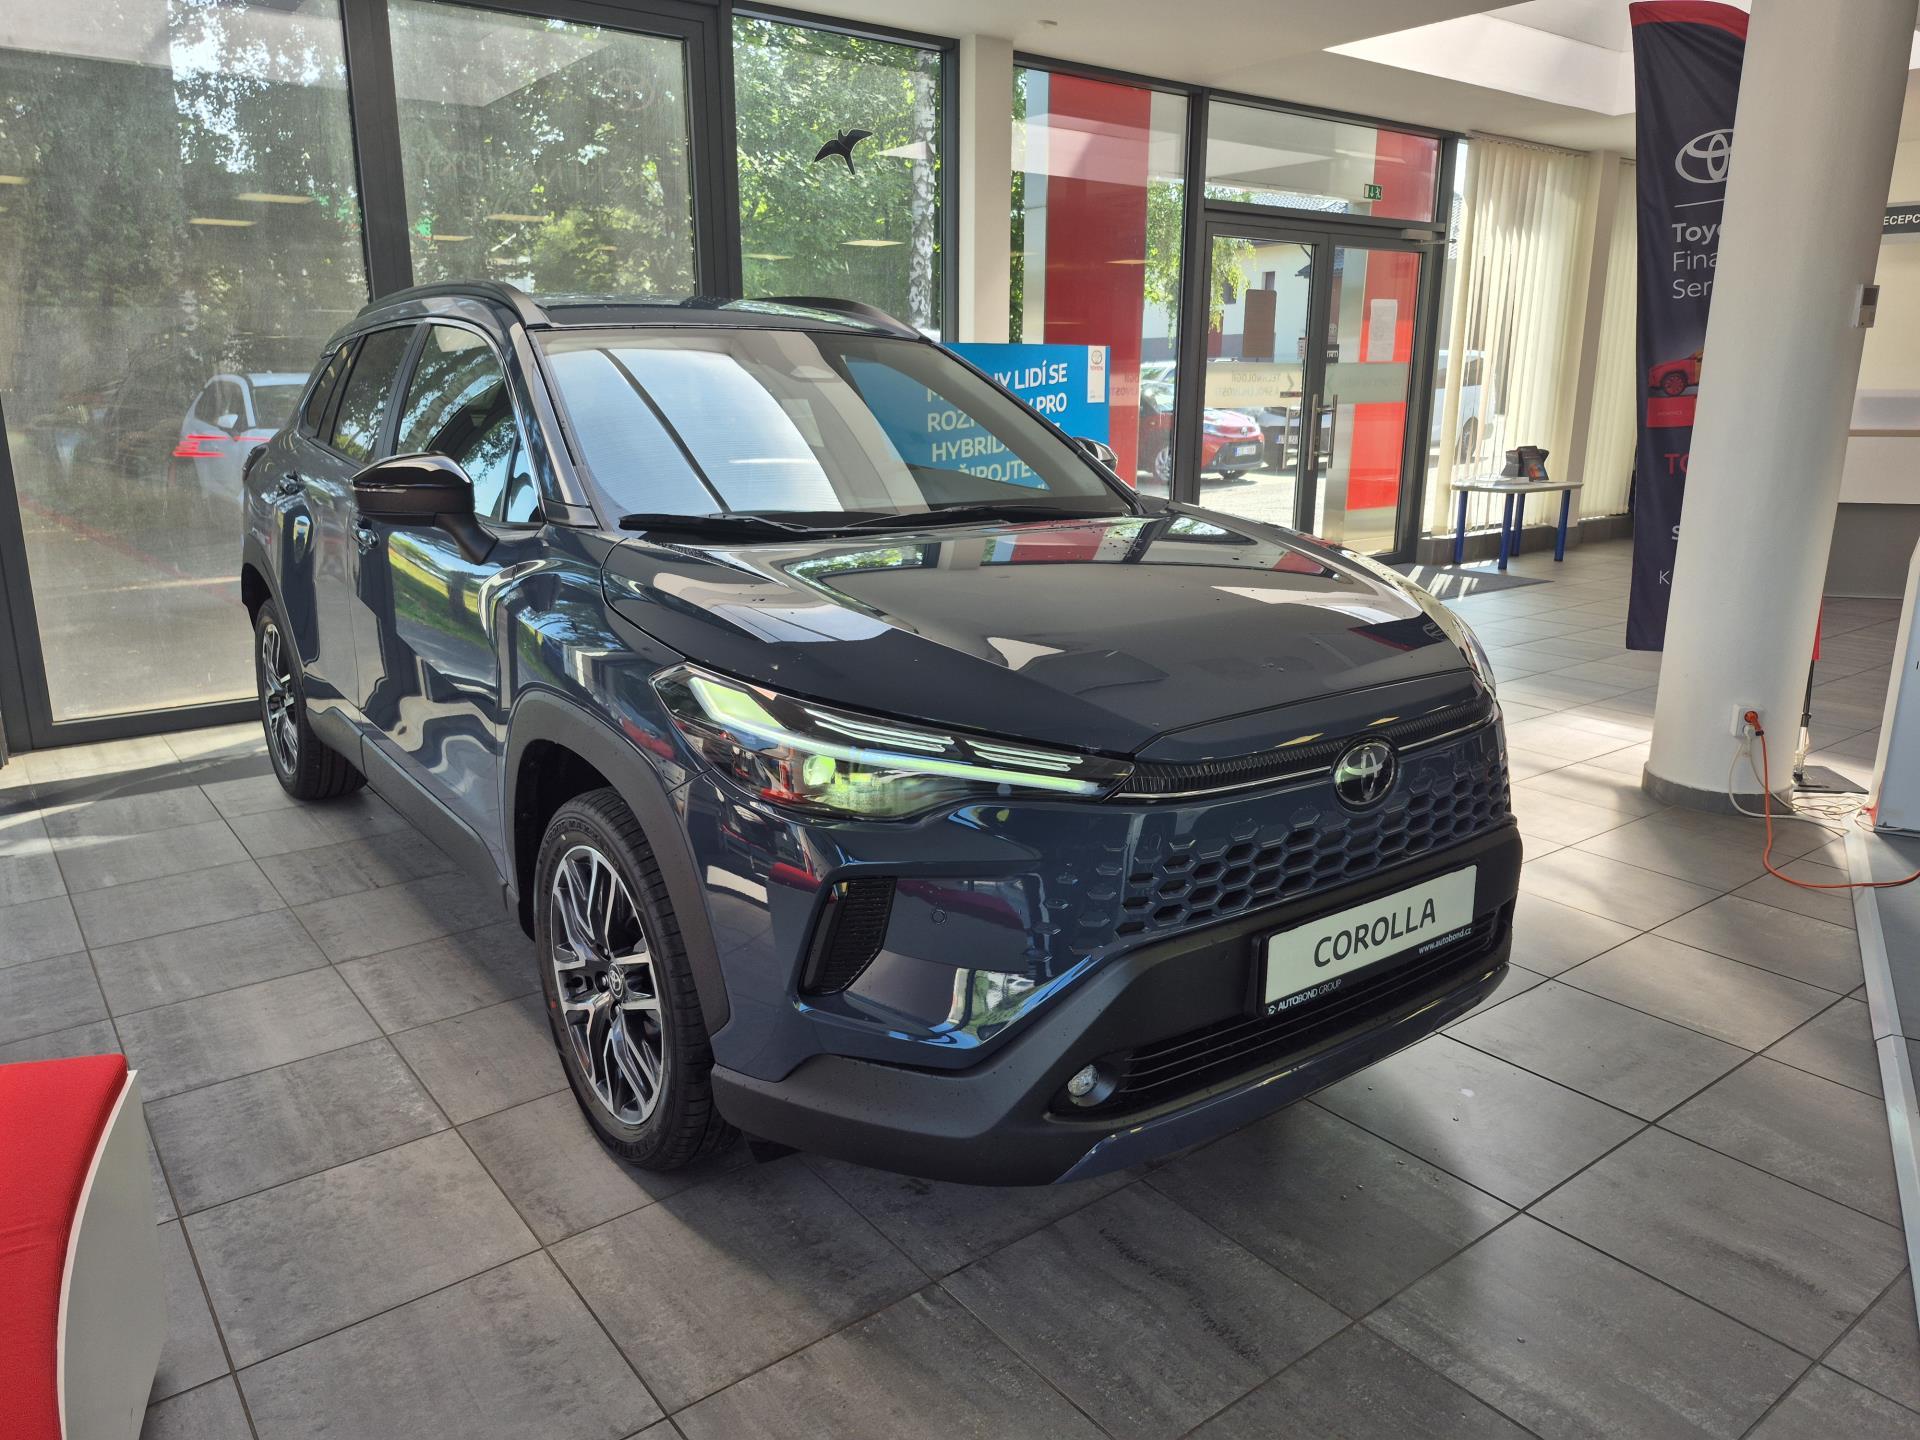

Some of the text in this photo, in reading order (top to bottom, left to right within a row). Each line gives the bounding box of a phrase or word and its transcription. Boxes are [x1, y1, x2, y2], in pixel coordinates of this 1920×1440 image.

[1883, 213, 1920, 225] ECEPC
[1671, 223, 1721, 245] Toy
[1673, 250, 1719, 272] Fina
[1672, 279, 1713, 299] Ser
[1014, 360, 1047, 390] LIDÍ
[1048, 363, 1068, 385] SE
[1036, 392, 1067, 415] PRO
[932, 434, 1009, 463] HYBRID
[1314, 898, 1436, 968] COROLLA
[1277, 979, 1342, 1012] AUTOBOND GROUP
